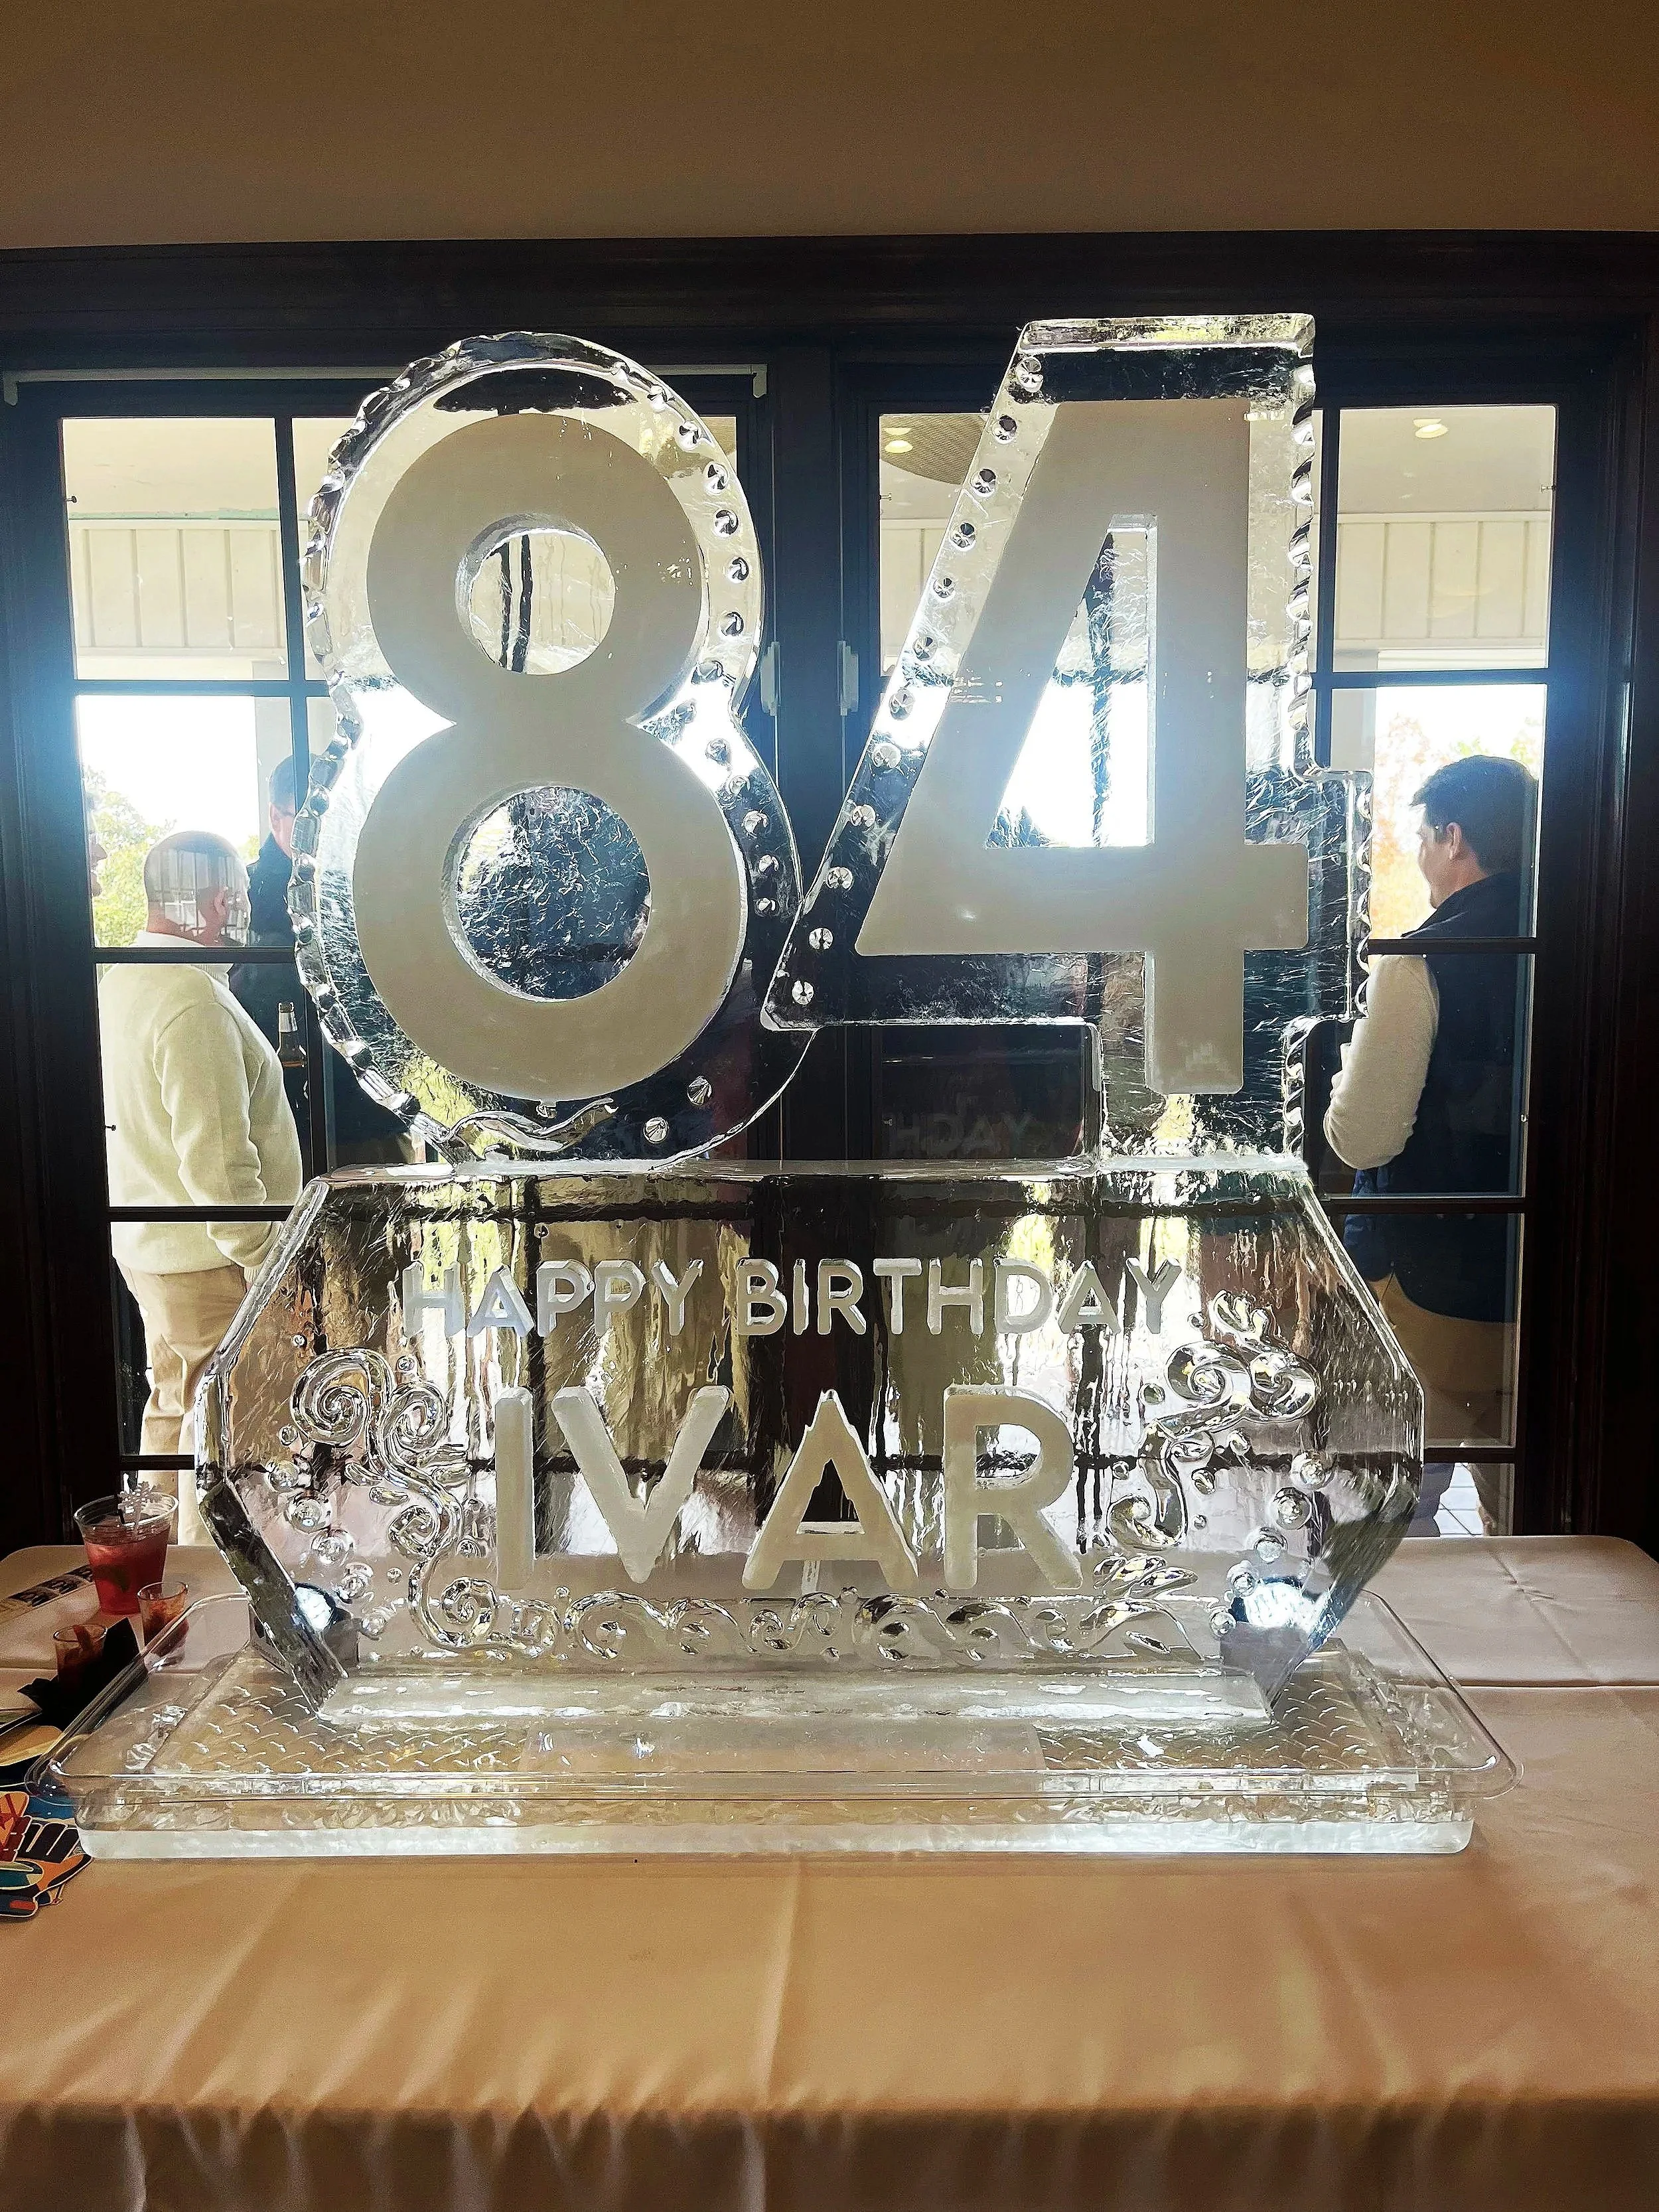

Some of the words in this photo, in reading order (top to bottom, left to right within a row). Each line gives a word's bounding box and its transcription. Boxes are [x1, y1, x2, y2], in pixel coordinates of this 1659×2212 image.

[353, 400, 1308, 1102] 84
[402, 1259, 703, 1337] HAPPY
[737, 1258, 1181, 1335] BIRTHDAY
[494, 1384, 1083, 1590] IVAR
